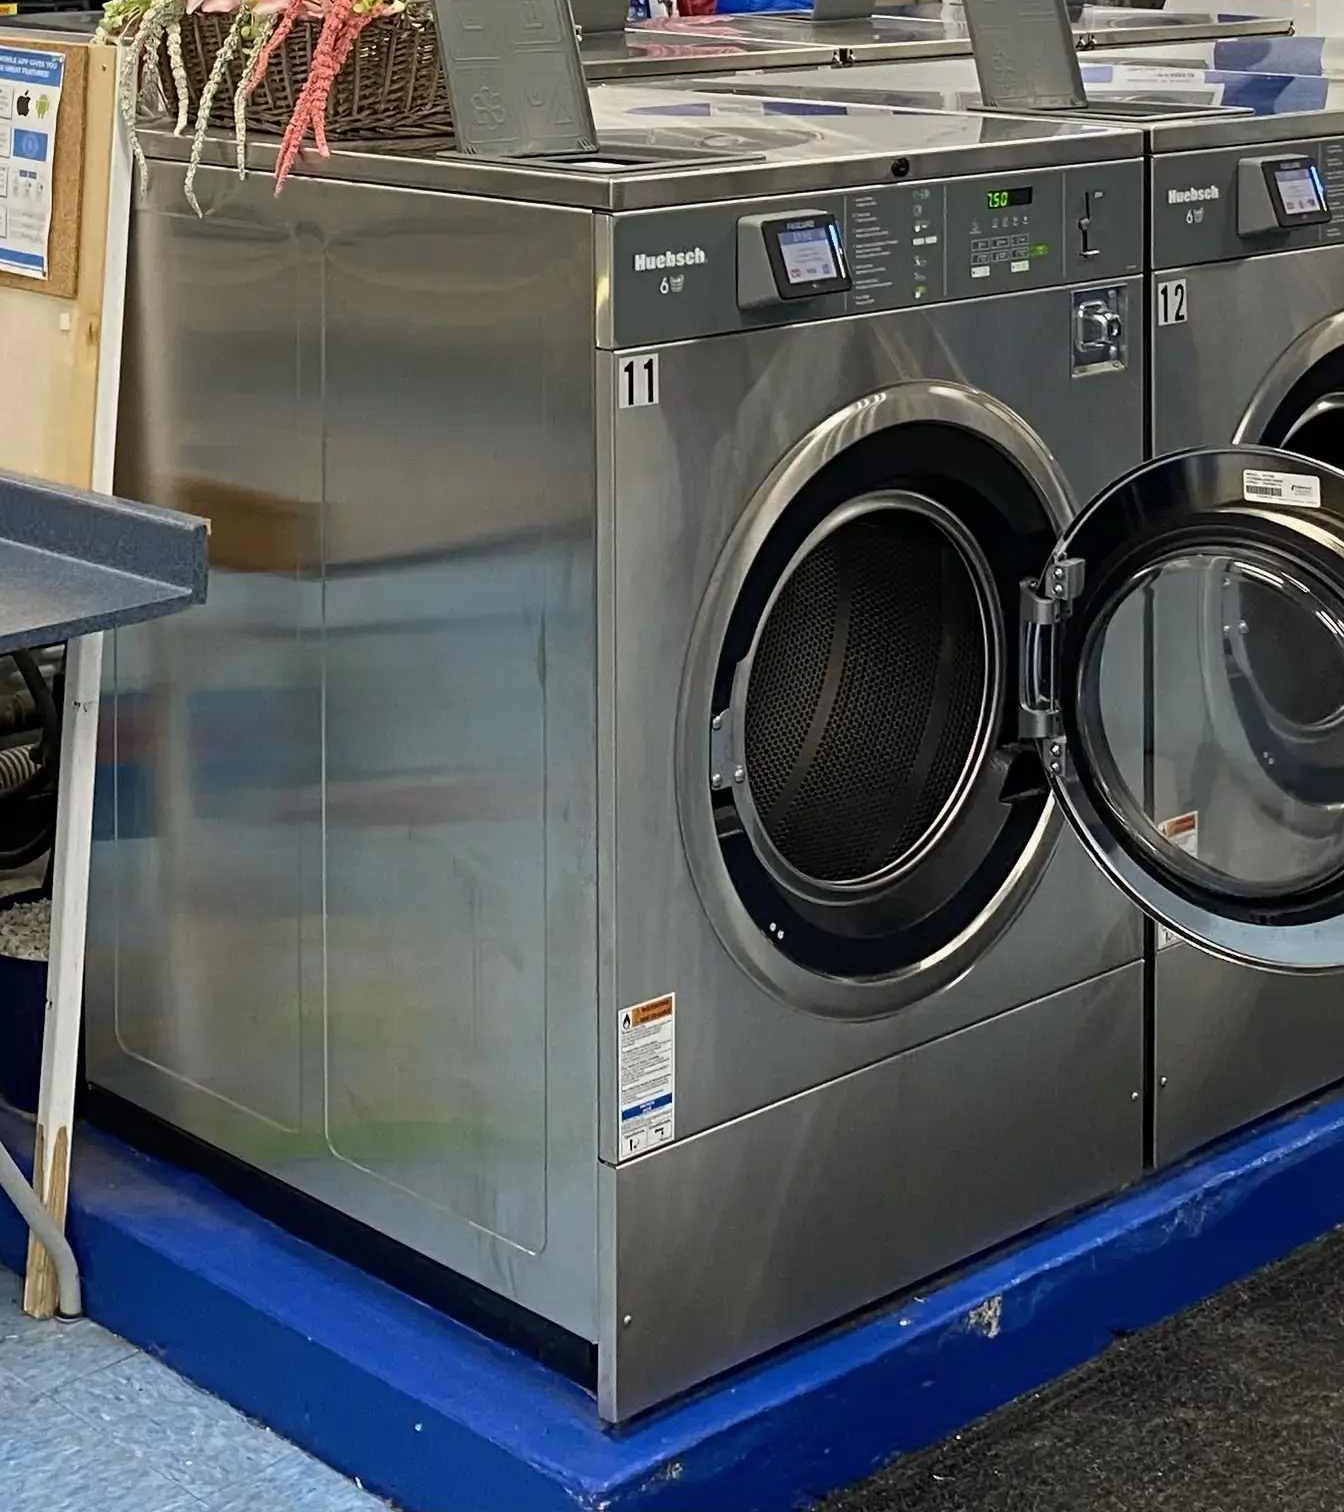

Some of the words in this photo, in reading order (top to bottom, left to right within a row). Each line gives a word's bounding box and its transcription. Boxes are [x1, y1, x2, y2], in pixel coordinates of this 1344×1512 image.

[1168, 184, 1219, 204] Huebsch
[1185, 209, 1193, 224] 6
[635, 247, 706, 271] Huebsch
[659, 277, 669, 294] 6
[1160, 284, 1185, 323] 12
[624, 358, 654, 406] 11
